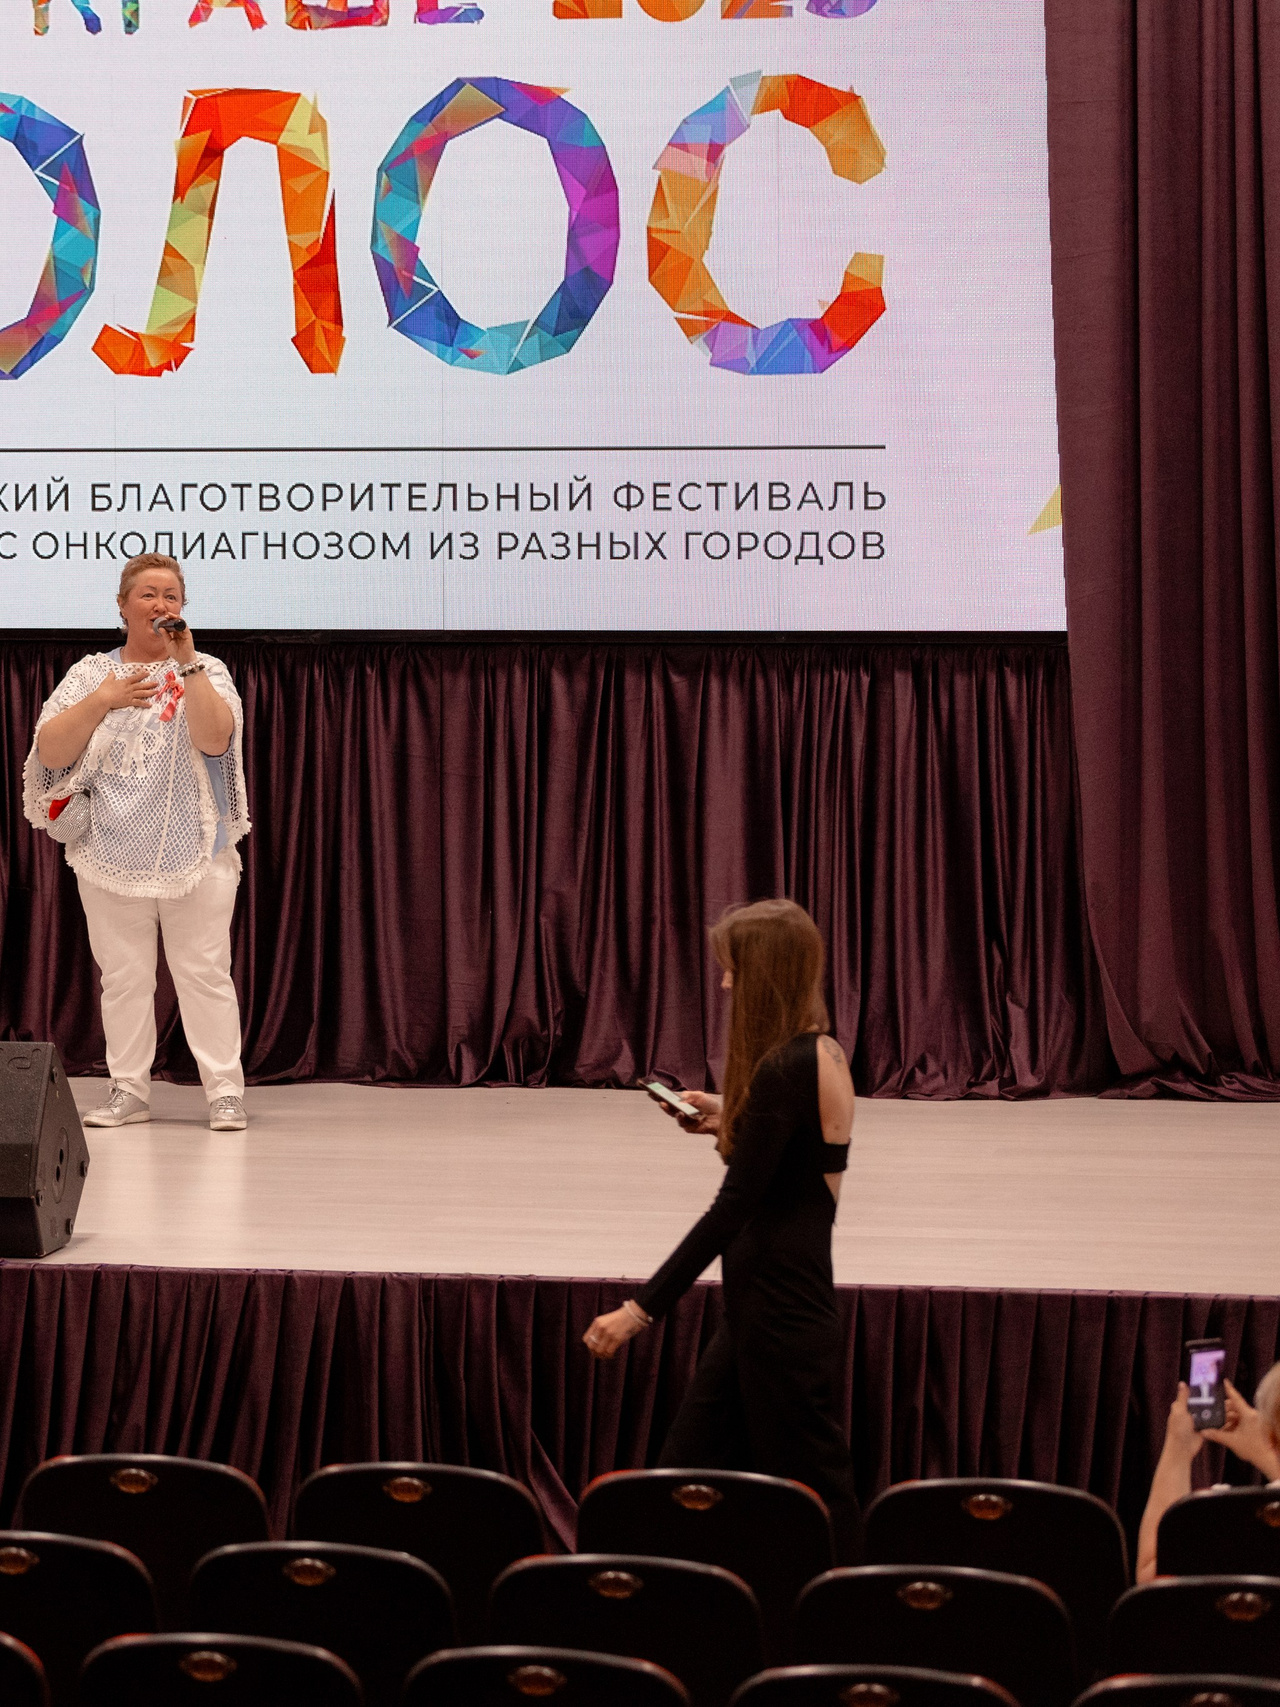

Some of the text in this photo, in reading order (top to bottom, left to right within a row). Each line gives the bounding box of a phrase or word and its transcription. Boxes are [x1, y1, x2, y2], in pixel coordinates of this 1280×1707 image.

[90, 474, 592, 513] БЛАГОТВОРИТЕЛЬНЫЙ
[613, 481, 887, 512] ФЕСТИВАЛЬ
[32, 530, 410, 562] ОНКОДИАГНОЗОМ
[430, 531, 480, 561] ИЗ
[497, 530, 668, 561] РАЗНЫХ
[685, 530, 885, 566] ГОРОДОВ
